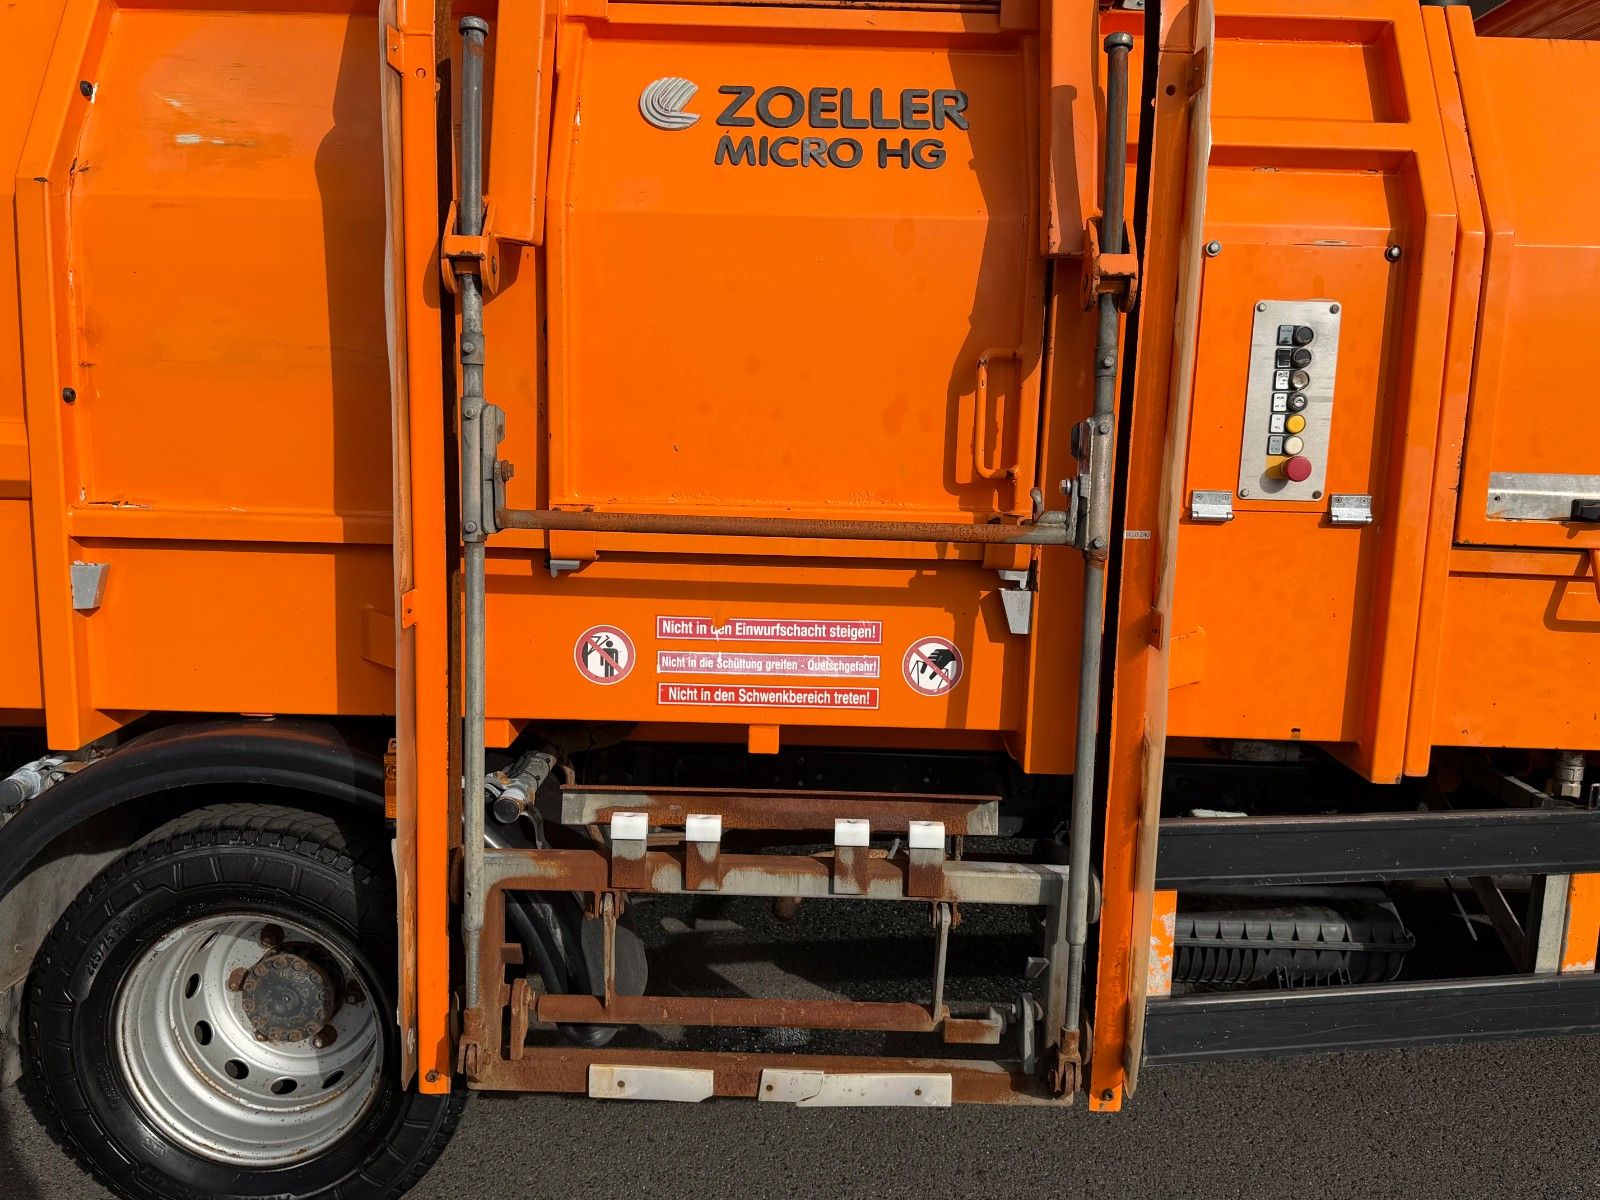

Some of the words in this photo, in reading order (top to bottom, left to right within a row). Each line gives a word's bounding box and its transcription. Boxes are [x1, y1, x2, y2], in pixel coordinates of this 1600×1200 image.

[715, 85, 970, 130] ZOELLER
[714, 136, 863, 168] MICRO
[877, 138, 947, 169] HG
[662, 620, 693, 634] Nicht
[696, 621, 707, 634] in
[735, 622, 826, 637] Einwurfschacht
[829, 624, 876, 640] steigen!
[662, 656, 685, 667] Nicht
[688, 656, 697, 667] in
[699, 657, 713, 668] die
[716, 658, 762, 671] Schüttung
[765, 659, 797, 671] greifen
[807, 660, 877, 673] Quetschgefahr!
[668, 687, 698, 700] Nicht
[700, 688, 710, 701] in
[714, 688, 735, 701] den
[738, 689, 830, 703] Schwenkbereich
[833, 691, 870, 705] treten!
